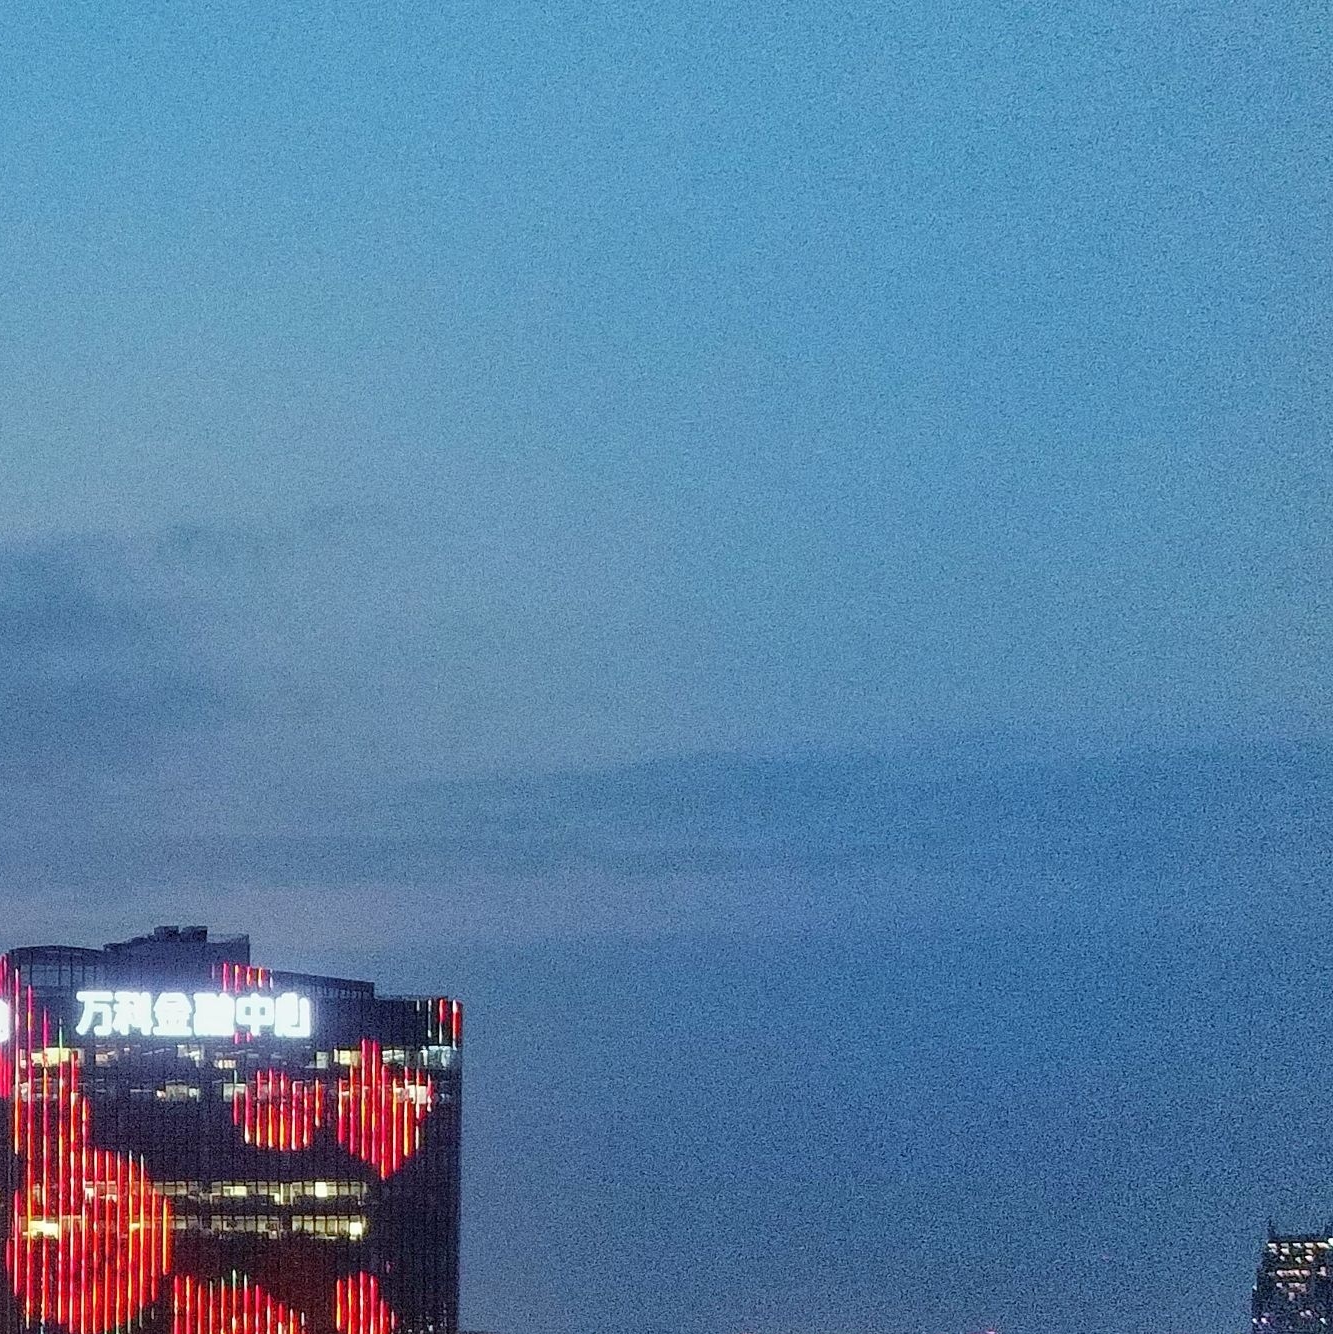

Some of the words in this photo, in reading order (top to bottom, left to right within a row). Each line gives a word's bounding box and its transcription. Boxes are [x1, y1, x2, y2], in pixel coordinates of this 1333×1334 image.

[76, 991, 311, 1038] 万科金融中心
